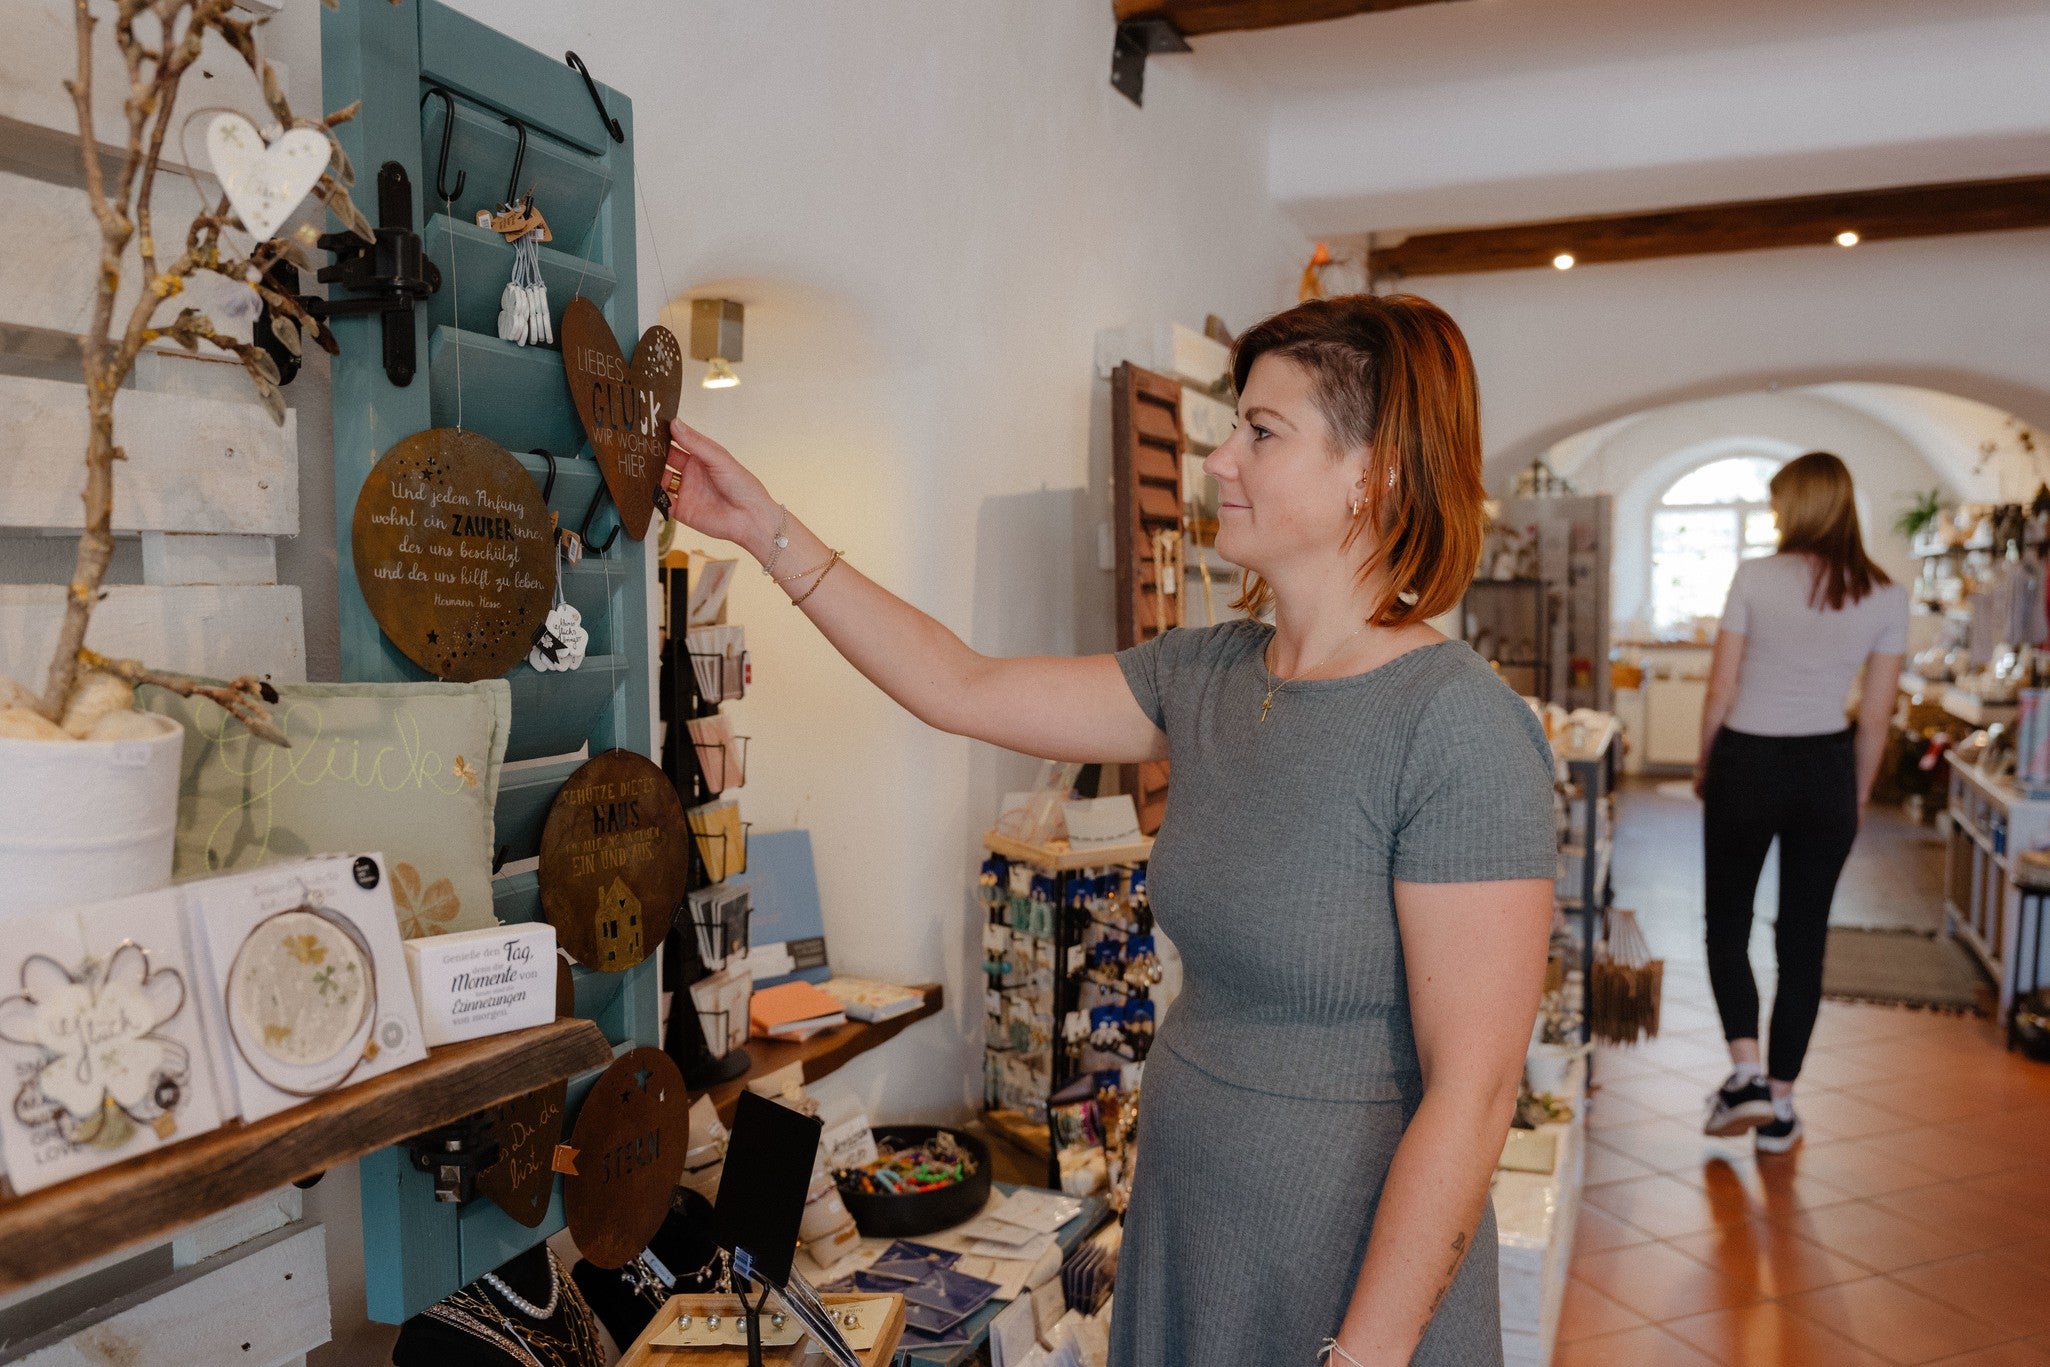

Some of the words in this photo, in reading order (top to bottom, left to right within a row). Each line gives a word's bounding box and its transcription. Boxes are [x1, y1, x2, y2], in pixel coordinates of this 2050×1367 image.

[577, 346, 625, 382] LIEBES
[592, 379, 661, 437] GLÜCK
[592, 427, 614, 447] WIR
[618, 432, 667, 458] WOHNEN
[618, 454, 646, 479] HIER
[391, 480, 428, 501] Und
[431, 485, 470, 507] jedem
[475, 489, 526, 519] Anfang
[371, 506, 417, 527] wohnt
[423, 516, 447, 530] ein
[452, 513, 515, 541] ZAUBER
[399, 534, 423, 555] der
[429, 544, 454, 557] uns
[460, 540, 521, 568] beschützt
[374, 561, 405, 580] und
[408, 562, 430, 581] der
[434, 571, 457, 584] uns
[461, 566, 491, 589] hilft
[495, 576, 512, 592] zu
[514, 571, 545, 590] leben.
[434, 593, 475, 608] Hermann
[479, 594, 503, 609] Hesse
[196, 703, 465, 874] Glück
[592, 800, 640, 835] HAUS
[572, 853, 596, 876] EIN
[600, 847, 628, 870] UND
[443, 949, 482, 964] Genieße
[483, 948, 500, 957] den
[503, 939, 534, 964] Tag,
[451, 965, 518, 993] Momente
[519, 970, 538, 980] von
[452, 990, 527, 1015] Erinnerungen
[452, 1015, 470, 1025] von
[508, 1121, 536, 1152] Du
[538, 1096, 560, 1126] da
[602, 1127, 660, 1185] STERN
